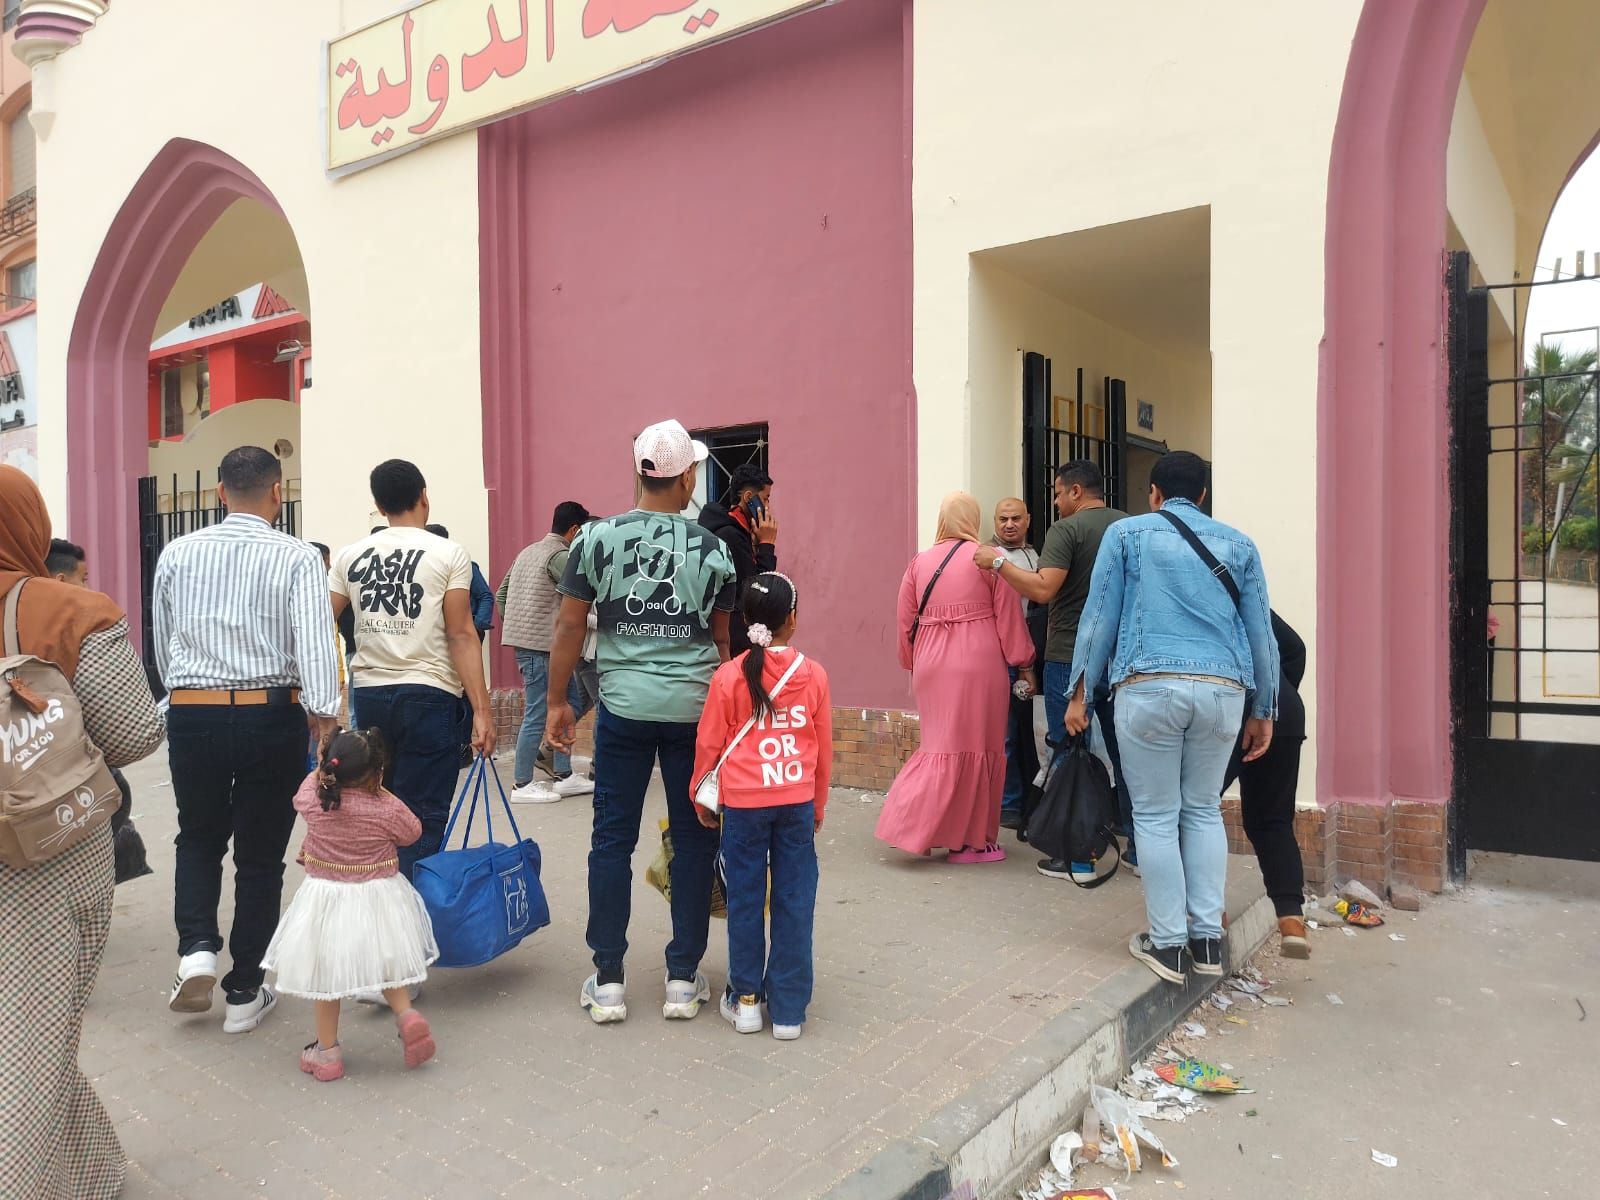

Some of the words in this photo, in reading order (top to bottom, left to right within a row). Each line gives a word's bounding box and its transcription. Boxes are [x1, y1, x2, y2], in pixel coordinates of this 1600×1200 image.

[347, 547, 426, 584] CASH
[359, 580, 425, 620] GRAB
[616, 622, 691, 638] FASHION
[30, 731, 55, 750] YOU
[758, 733, 800, 760] OR
[761, 760, 803, 787] NO
